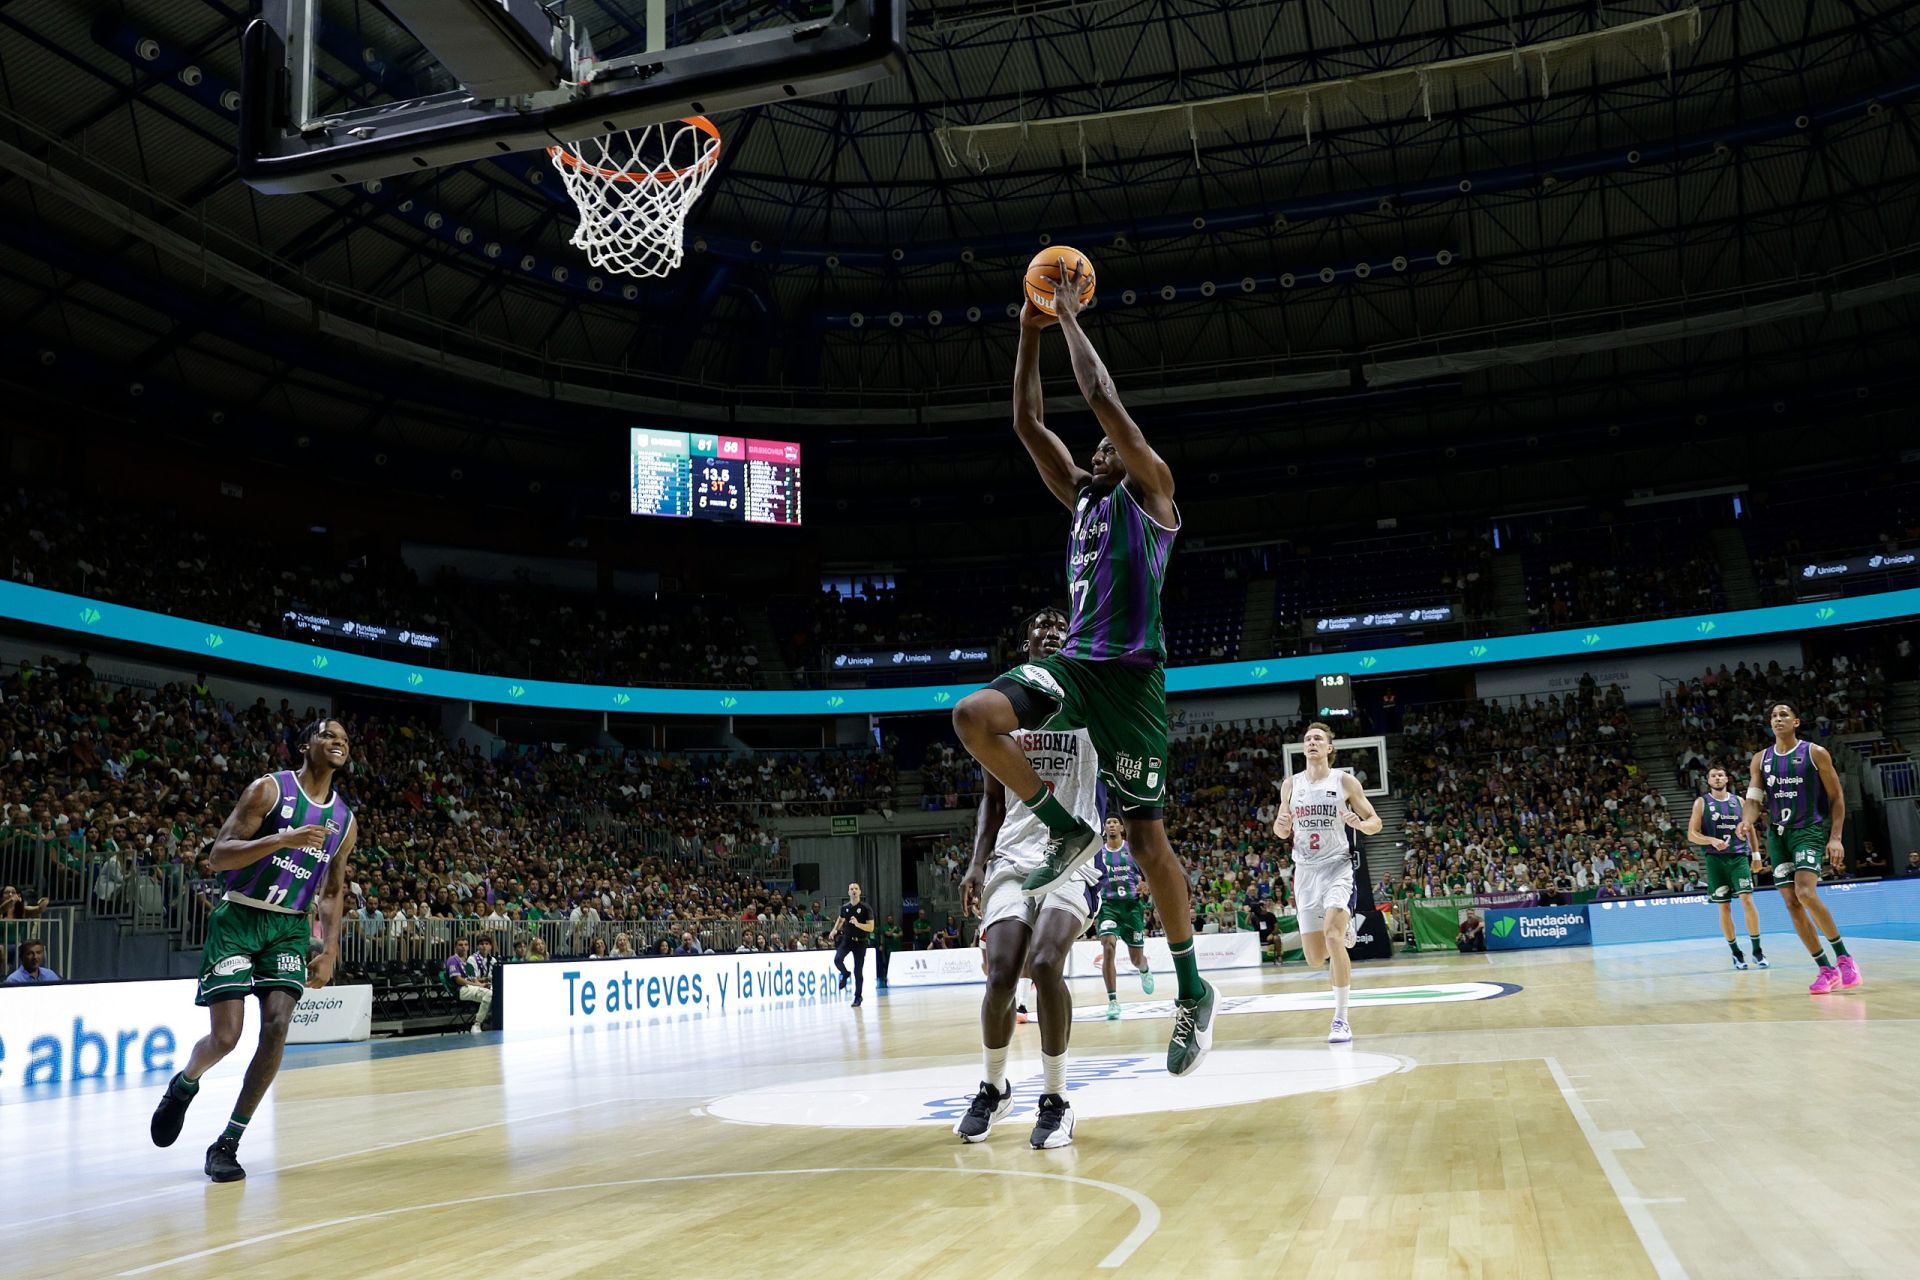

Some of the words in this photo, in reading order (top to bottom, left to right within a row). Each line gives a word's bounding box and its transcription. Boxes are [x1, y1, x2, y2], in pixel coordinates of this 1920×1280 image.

[1883, 554, 1915, 565] Unicaja
[1817, 564, 1848, 575] Unicaja
[1375, 612, 1403, 621] Fundación
[1421, 607, 1450, 616] Fundación
[410, 632, 440, 643] Fundación
[410, 638, 432, 648] Unicaja
[905, 654, 931, 663] Unicaja
[961, 651, 987, 660] Unicaja
[847, 657, 874, 666] Unicaja
[1321, 675, 1344, 686] 13.3
[1016, 733, 1078, 757] ASKONIA
[1776, 775, 1804, 785] Unicaja
[1310, 833, 1320, 849] 2
[1723, 834, 1731, 846] 7
[264, 884, 289, 905] 11
[1117, 886, 1126, 897] 6
[1519, 913, 1584, 927] Fundación
[1520, 926, 1568, 939] Unicaja
[563, 971, 596, 1016] Te
[605, 970, 711, 1010] atreves,
[717, 972, 729, 1008] y
[737, 961, 753, 999] la
[757, 961, 794, 997] vida
[798, 965, 816, 996] se
[23, 1016, 177, 1086] abre
